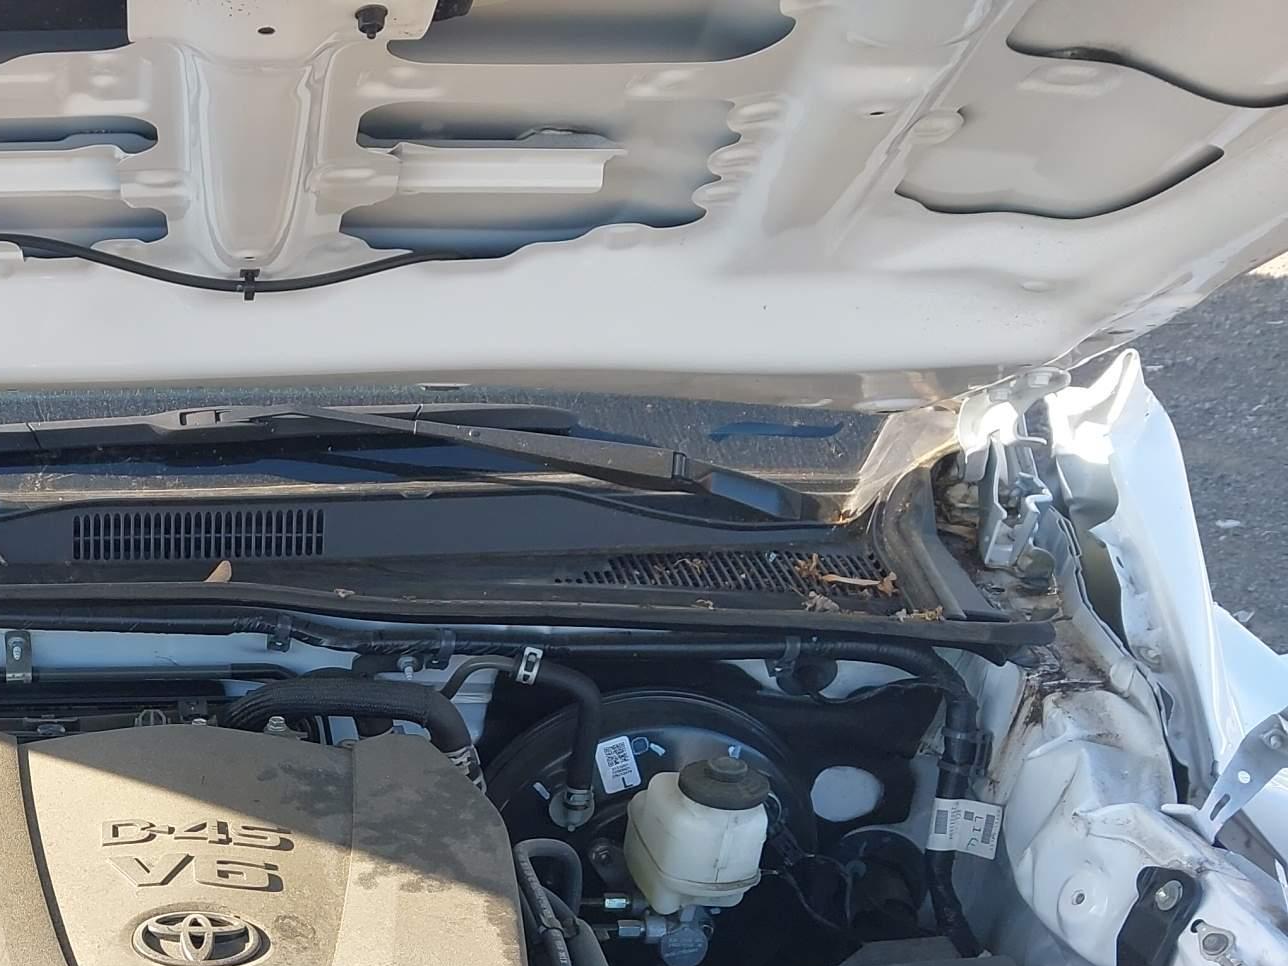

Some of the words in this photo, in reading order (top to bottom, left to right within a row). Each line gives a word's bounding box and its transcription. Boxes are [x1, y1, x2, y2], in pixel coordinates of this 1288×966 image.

[622, 776, 633, 788] L
[101, 818, 293, 851] D-4S
[106, 854, 283, 892] V6
